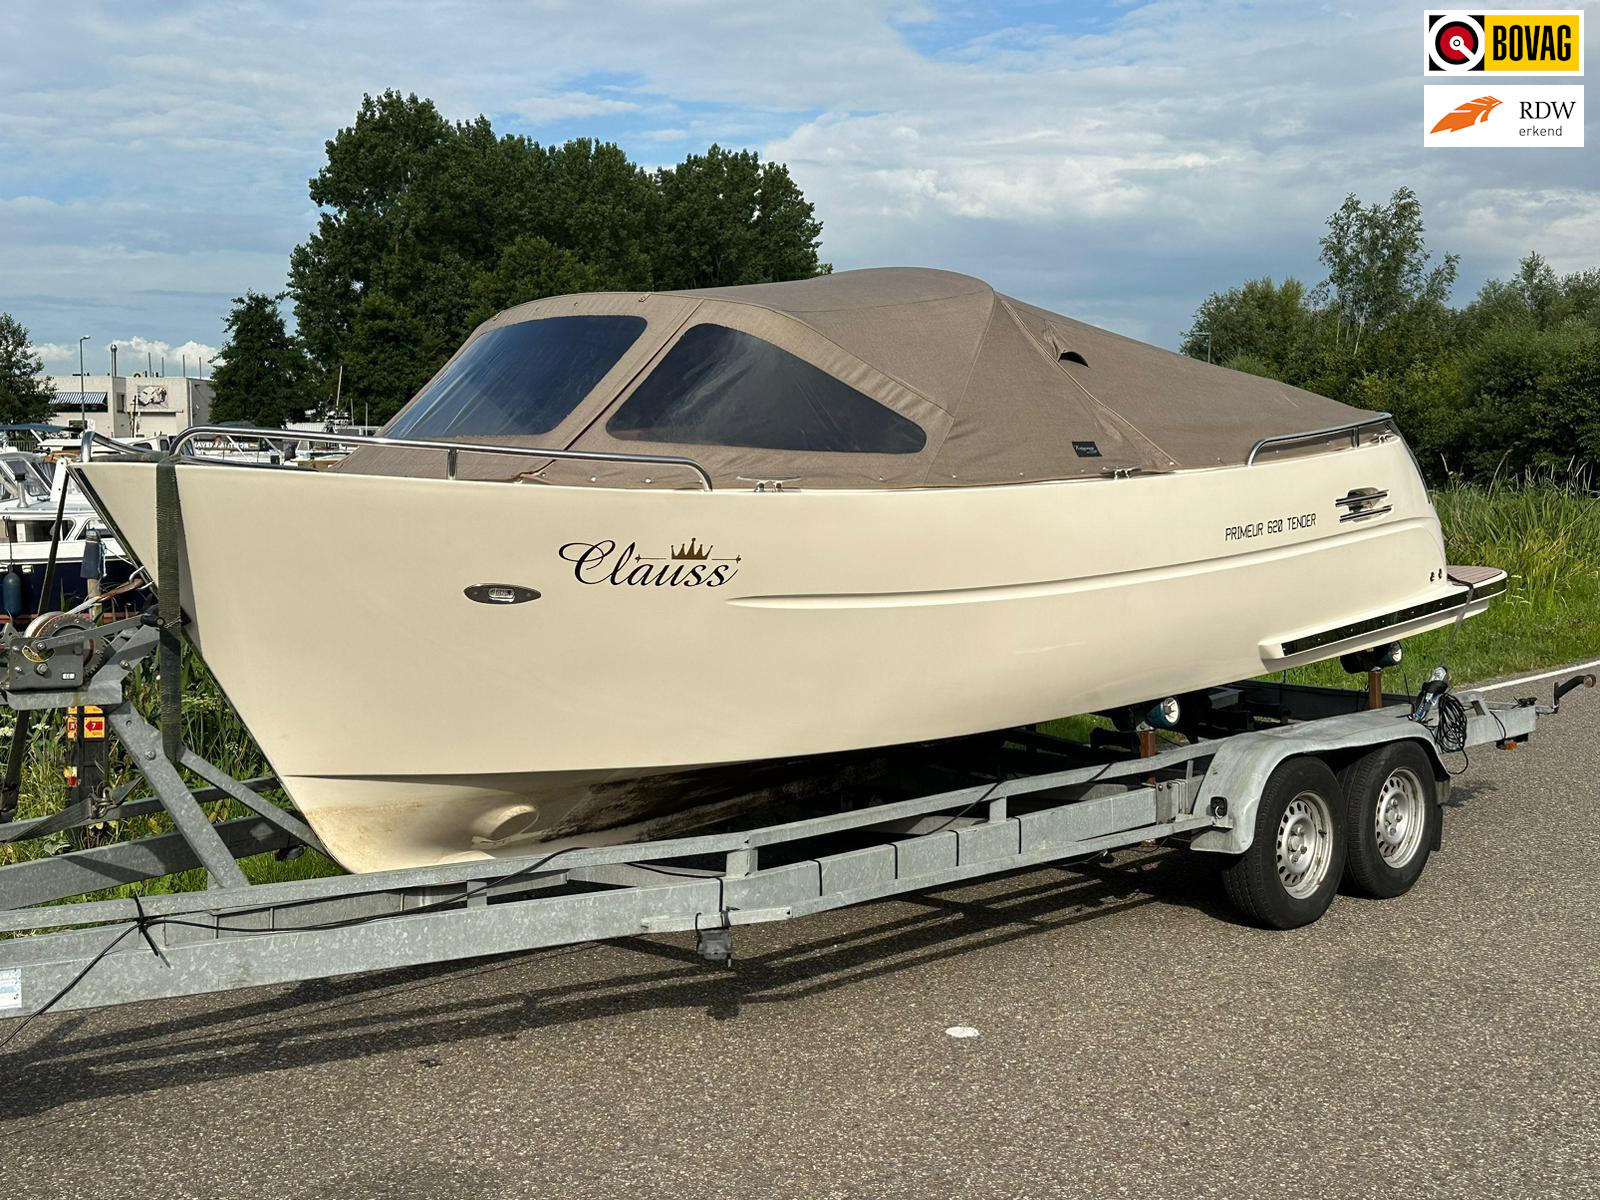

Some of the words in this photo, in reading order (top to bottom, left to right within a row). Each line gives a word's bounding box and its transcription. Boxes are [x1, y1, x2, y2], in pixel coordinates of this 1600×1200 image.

[1225, 522, 1264, 541] PRIMEUR
[1267, 519, 1283, 534] 620
[1287, 513, 1317, 531] TENDER
[558, 540, 738, 587] Clauss
